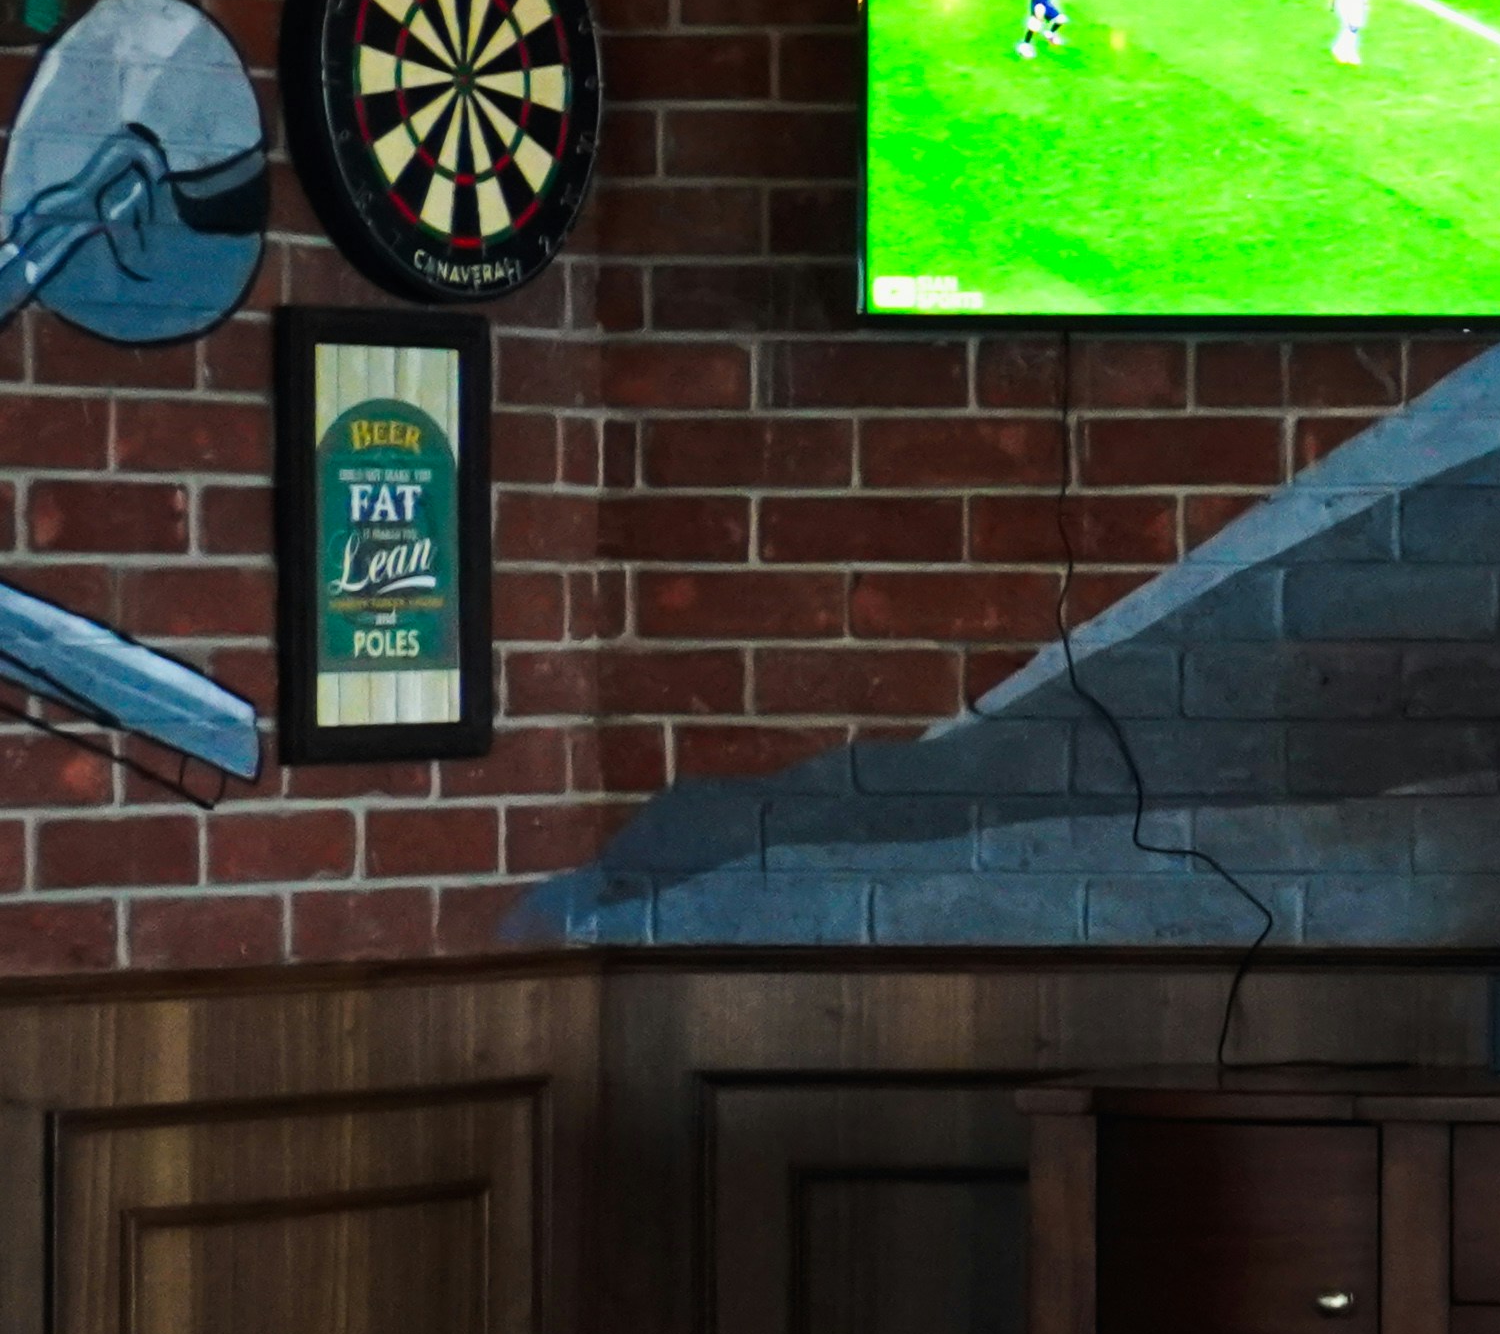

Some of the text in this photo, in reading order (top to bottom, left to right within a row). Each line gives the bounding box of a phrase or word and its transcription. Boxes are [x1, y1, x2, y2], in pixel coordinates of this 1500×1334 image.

[351, 419, 422, 454] BEER
[350, 484, 422, 522] FAT
[329, 533, 434, 594] Lean
[354, 629, 420, 660] POLES
